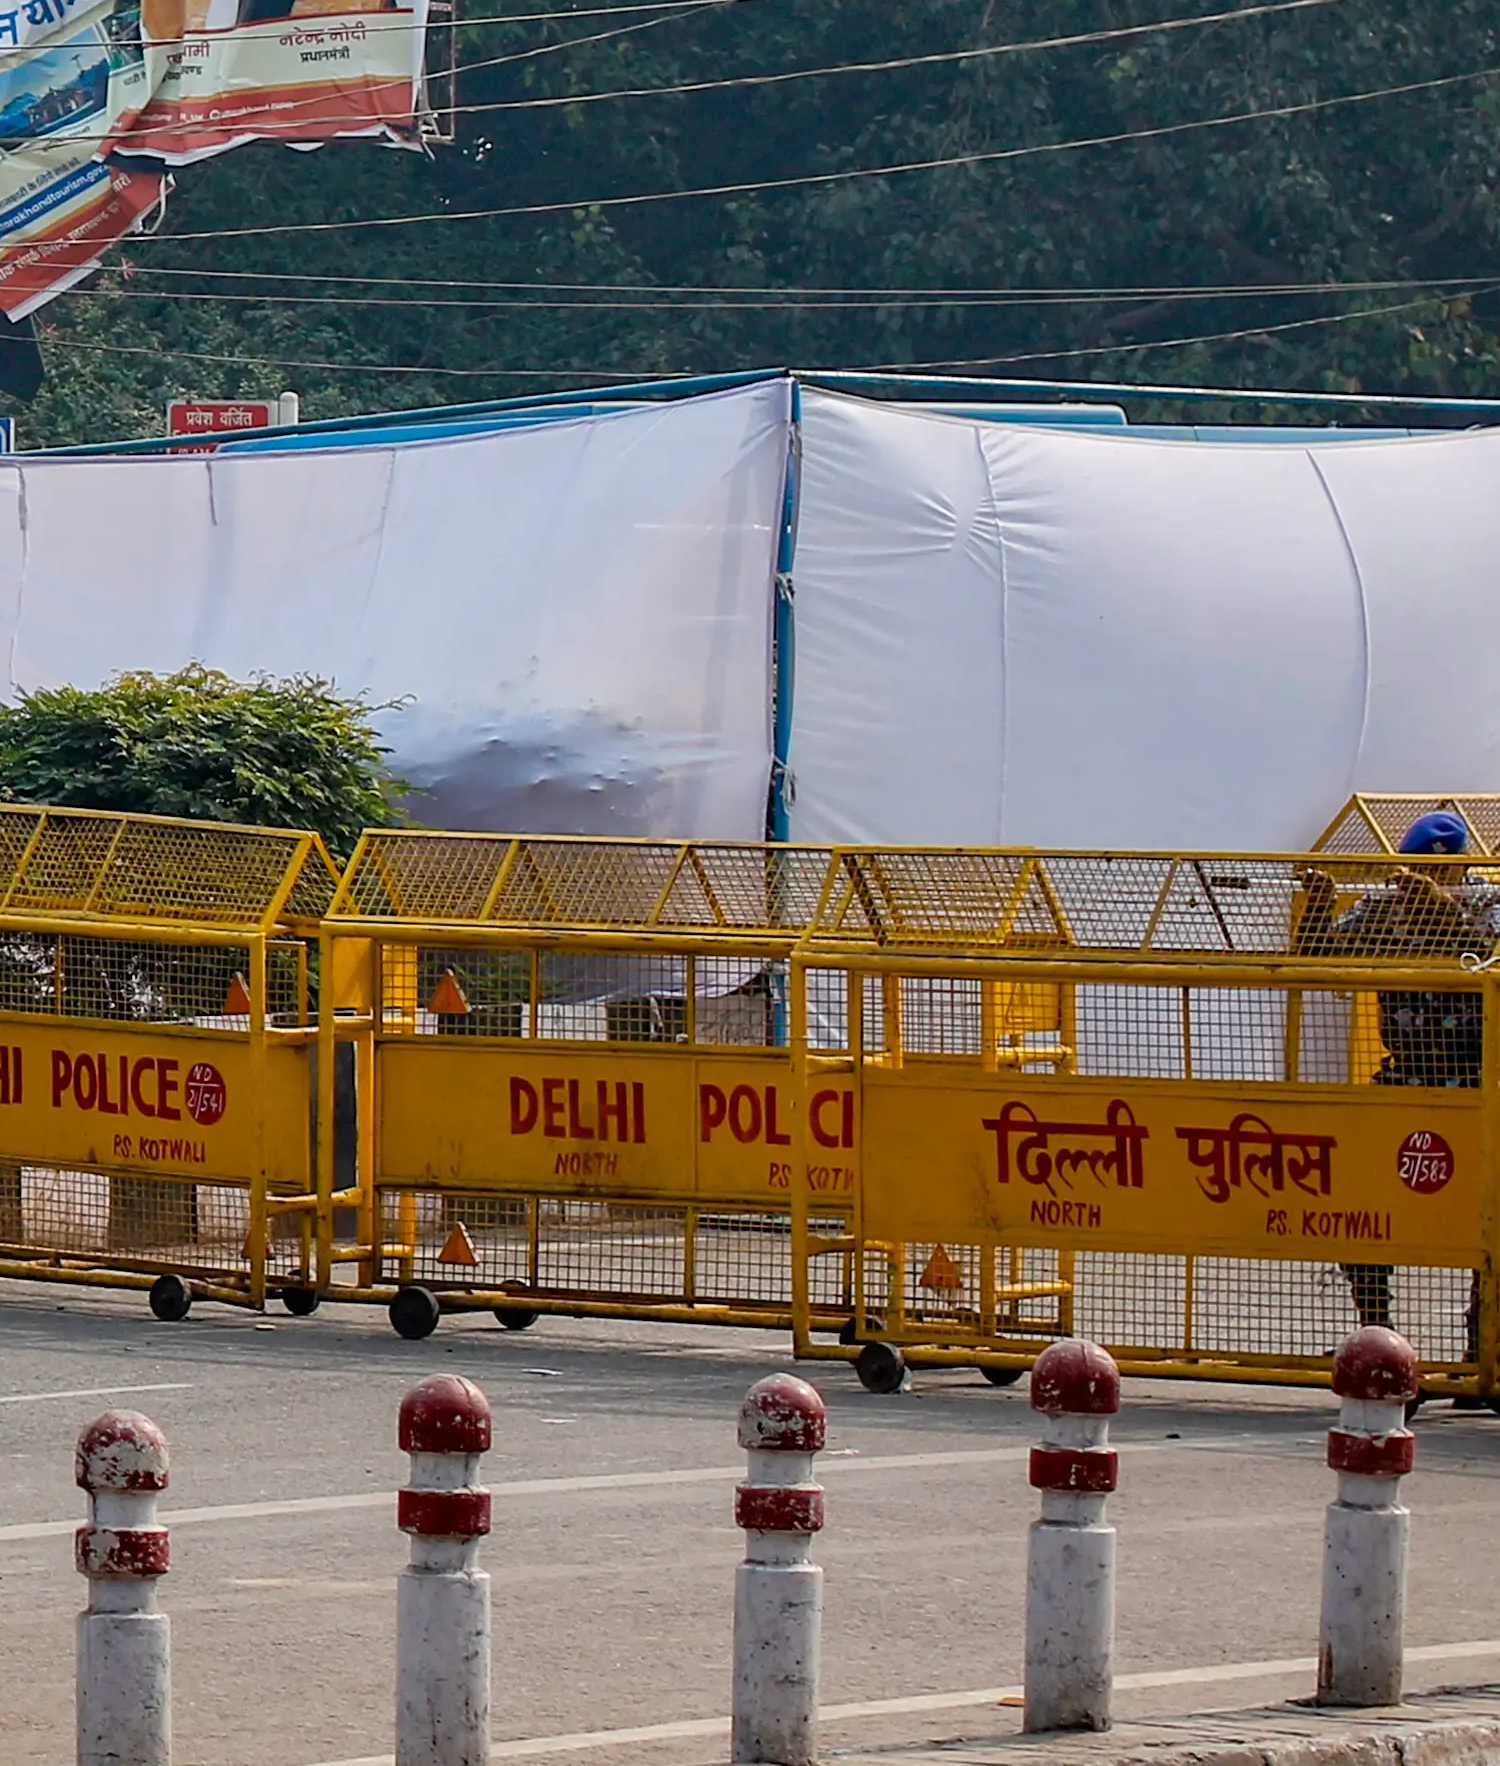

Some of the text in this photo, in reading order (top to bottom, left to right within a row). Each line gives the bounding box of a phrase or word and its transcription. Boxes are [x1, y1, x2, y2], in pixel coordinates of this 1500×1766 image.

[186, 406, 253, 427] प्रवेश वर्जित
[51, 1049, 182, 1122] POLICE
[508, 1076, 647, 1145] DELHI
[139, 1136, 207, 1164] KOTWALI
[982, 1099, 1339, 1204] दिल्ली पुलिस
[1409, 1131, 1433, 1151] ND
[554, 1152, 619, 1177] NORTH
[1031, 1199, 1100, 1228] NORTH
[1301, 1208, 1392, 1242] KOTWALI
